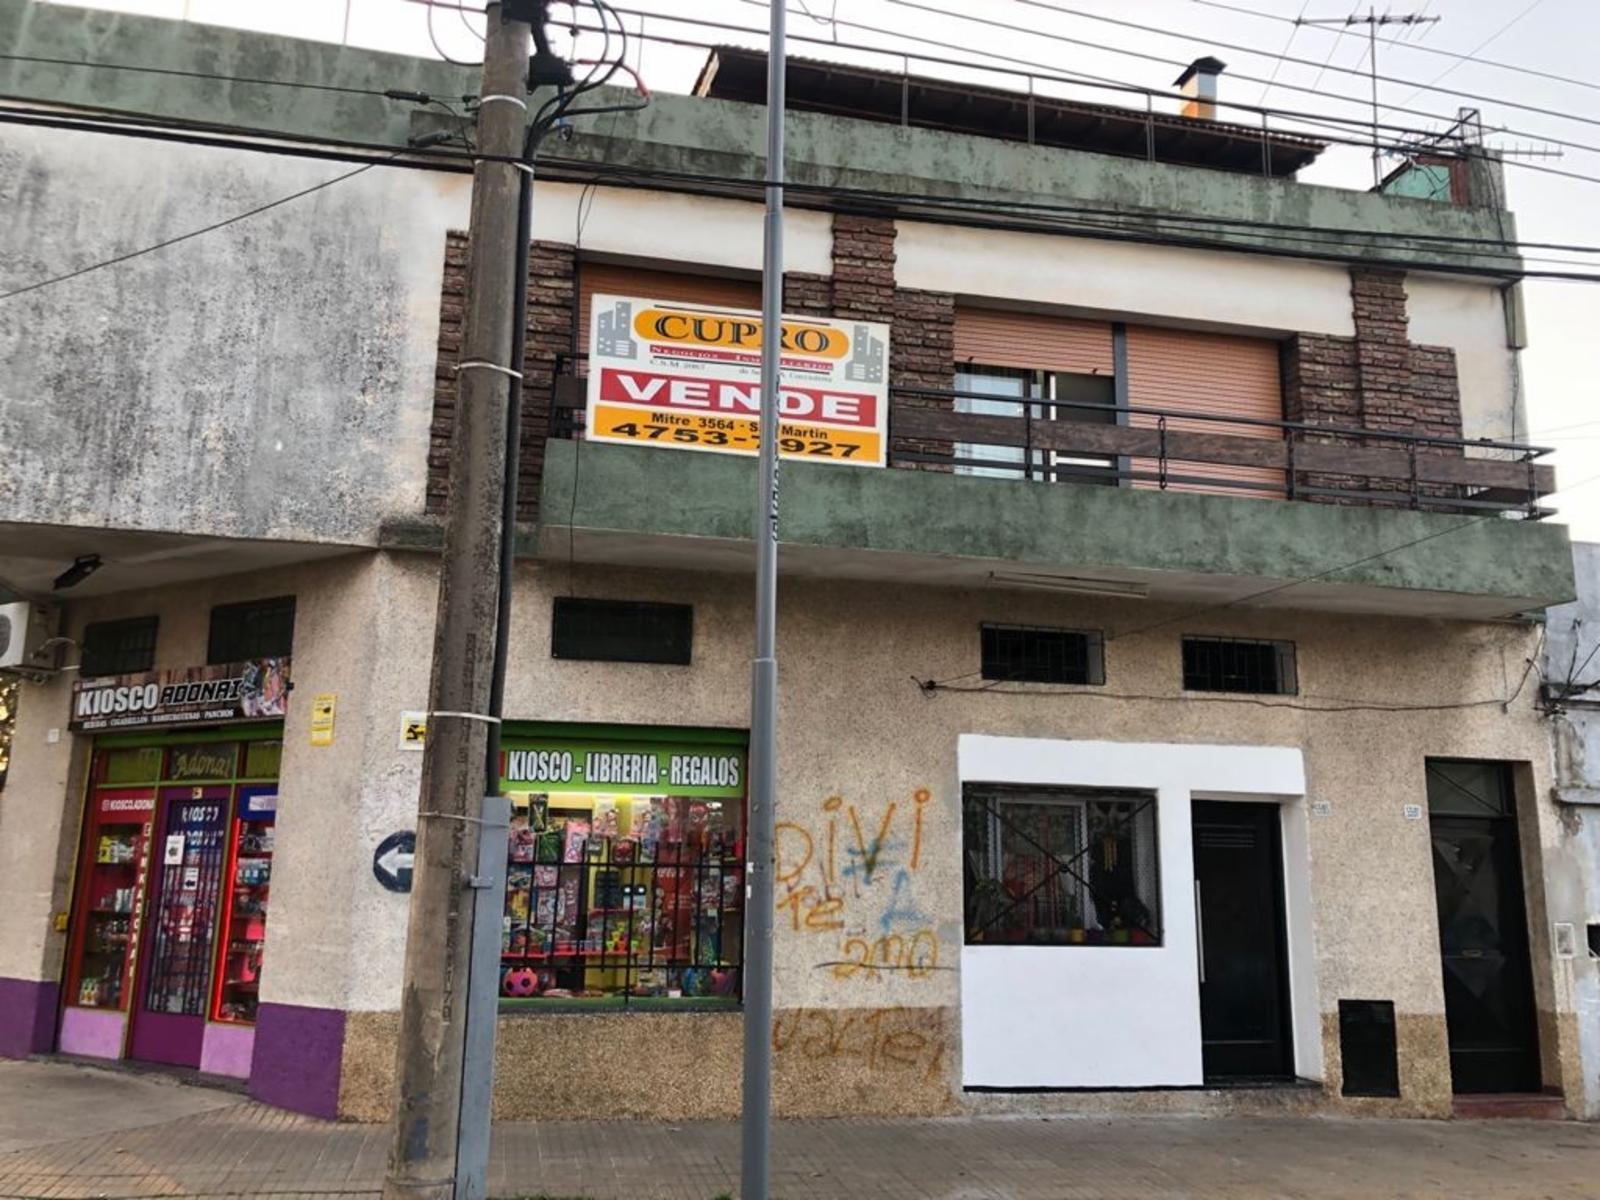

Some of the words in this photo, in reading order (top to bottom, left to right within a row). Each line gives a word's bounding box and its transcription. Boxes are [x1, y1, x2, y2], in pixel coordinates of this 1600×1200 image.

[617, 374, 860, 422] VENDE
[652, 412, 690, 426] Mitre
[698, 417, 734, 430] 3564
[781, 424, 828, 439] Martin
[78, 683, 160, 716] KIOSCO
[161, 679, 243, 704] ADONAI
[508, 750, 573, 782] KIOSCO
[585, 752, 658, 784] LIBRERIA
[670, 755, 739, 787] REGALOS
